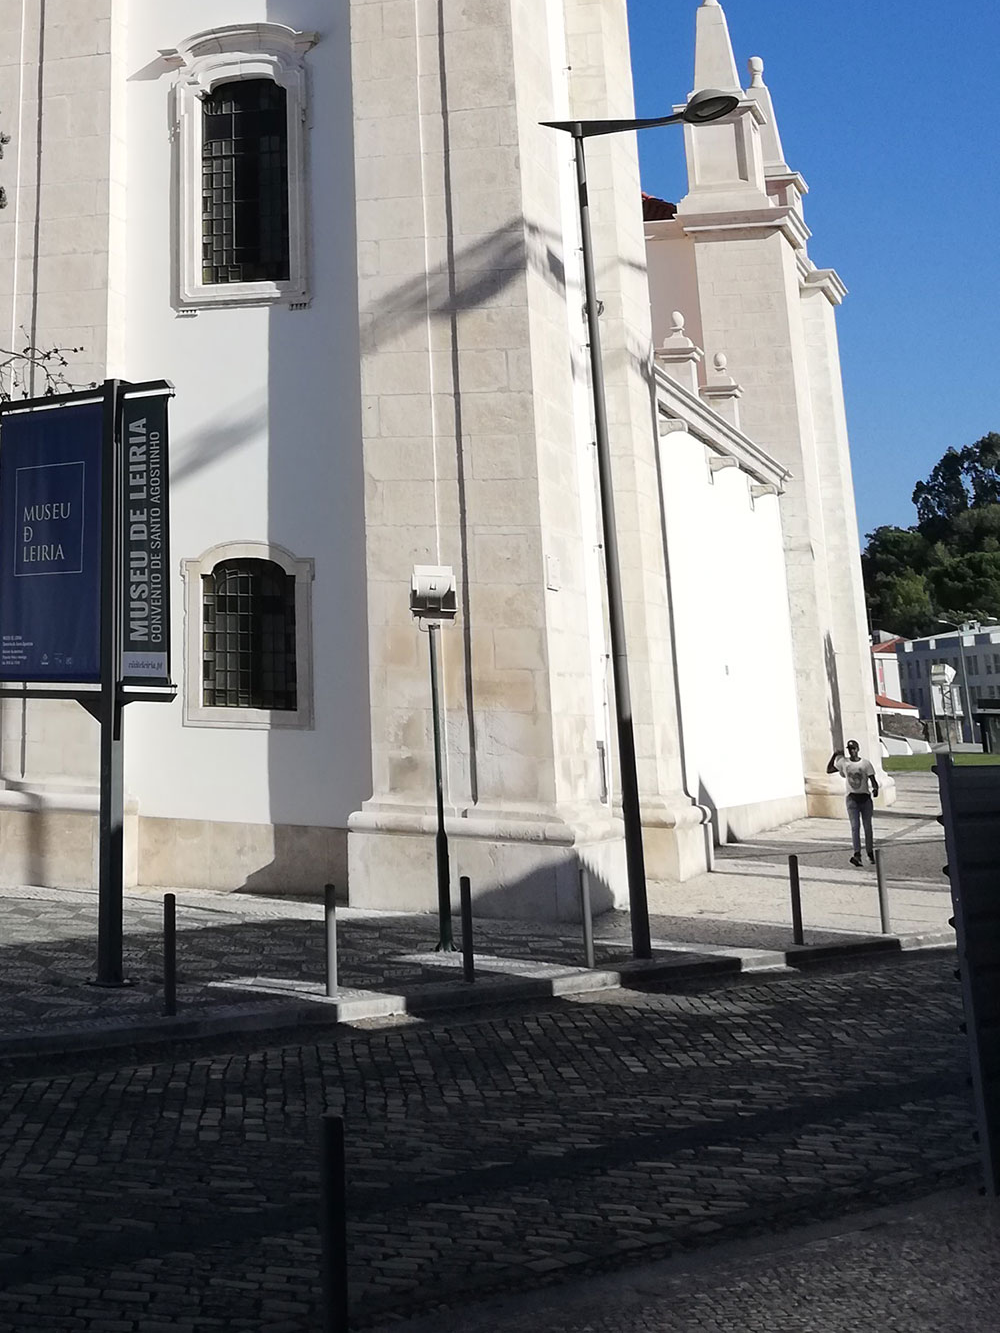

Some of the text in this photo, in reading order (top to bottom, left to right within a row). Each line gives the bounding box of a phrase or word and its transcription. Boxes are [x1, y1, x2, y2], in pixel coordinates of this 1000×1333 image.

[23, 544, 65, 562] LEIRIA
[24, 502, 71, 522] MUSEU
[129, 417, 149, 642] MUSEU DE LEIRIA
[149, 431, 162, 643] CONVENTO DE SANTO AGOSTINHO
